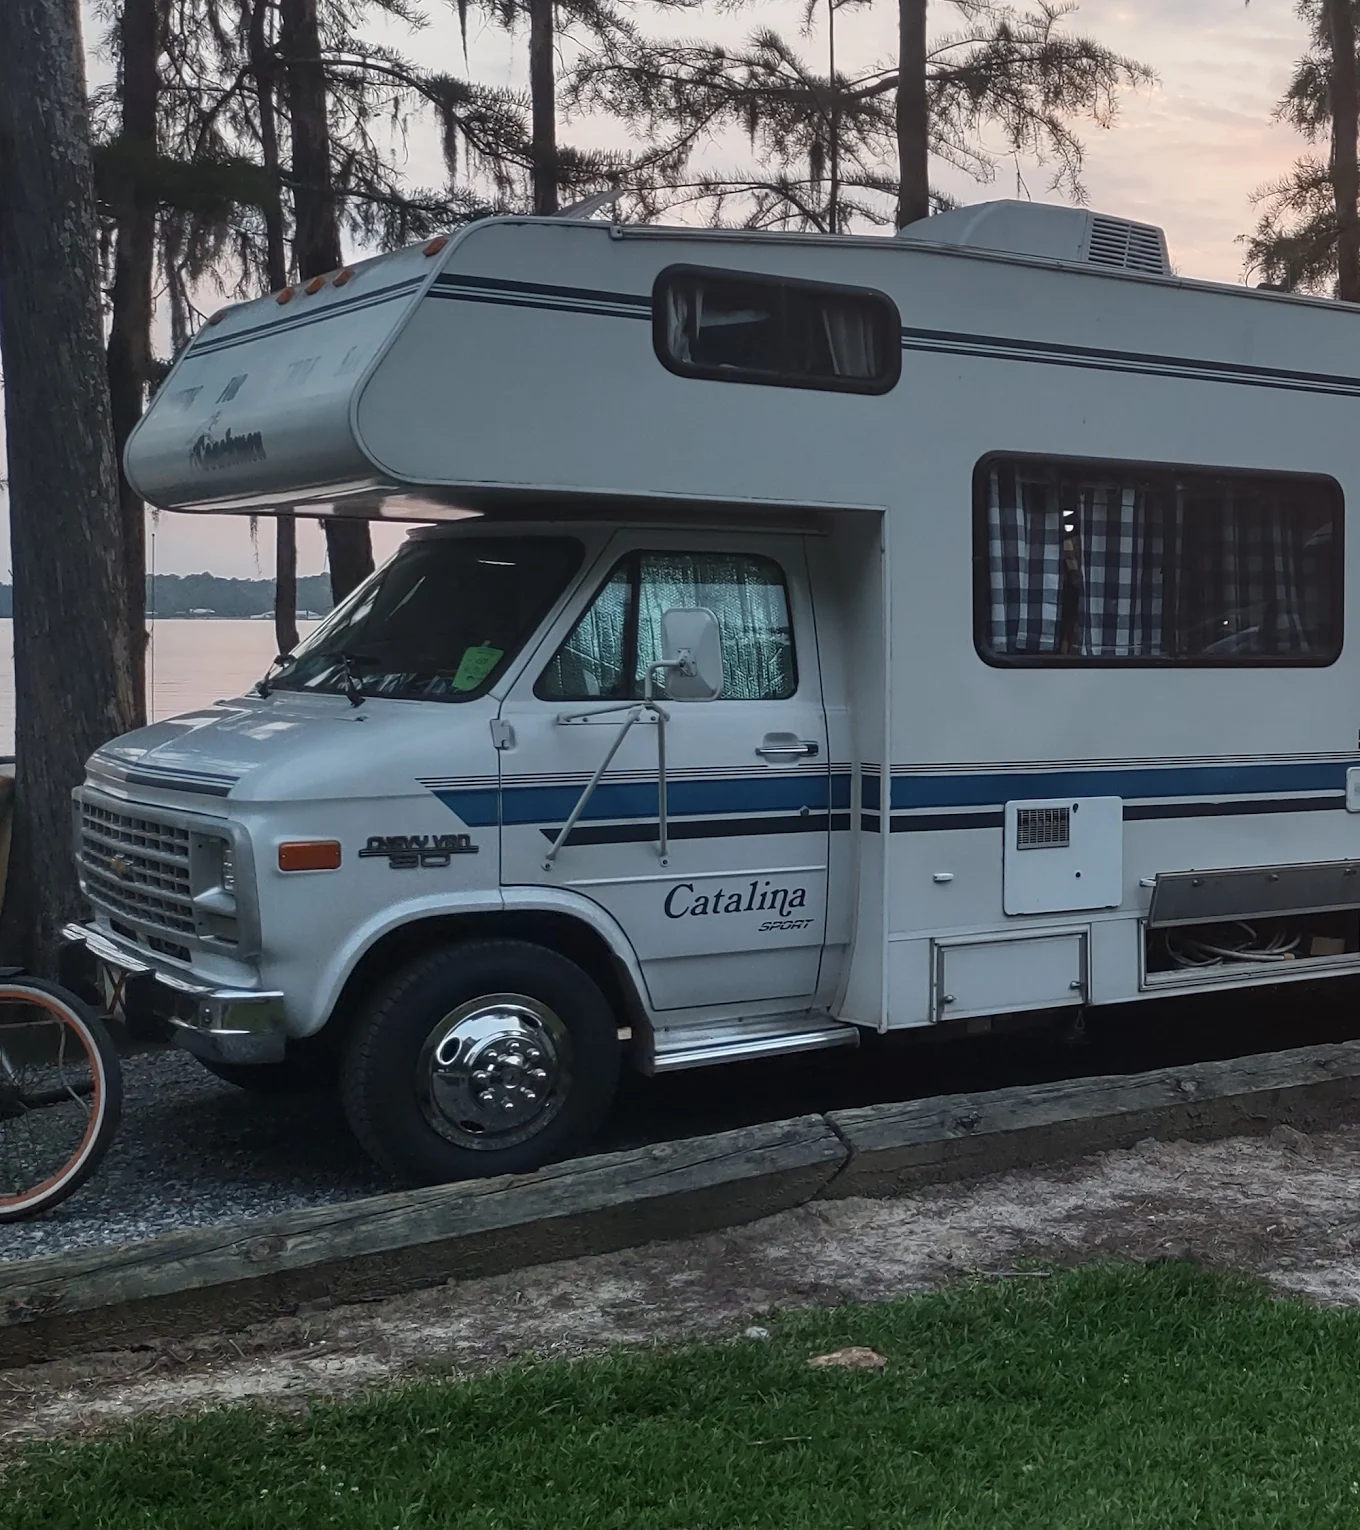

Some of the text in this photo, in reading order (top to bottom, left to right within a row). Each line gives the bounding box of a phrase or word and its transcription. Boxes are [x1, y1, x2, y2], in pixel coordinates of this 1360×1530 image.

[367, 833, 471, 850] CHEVY VAN
[664, 880, 807, 919] Catalina
[757, 918, 815, 932] SPORT
